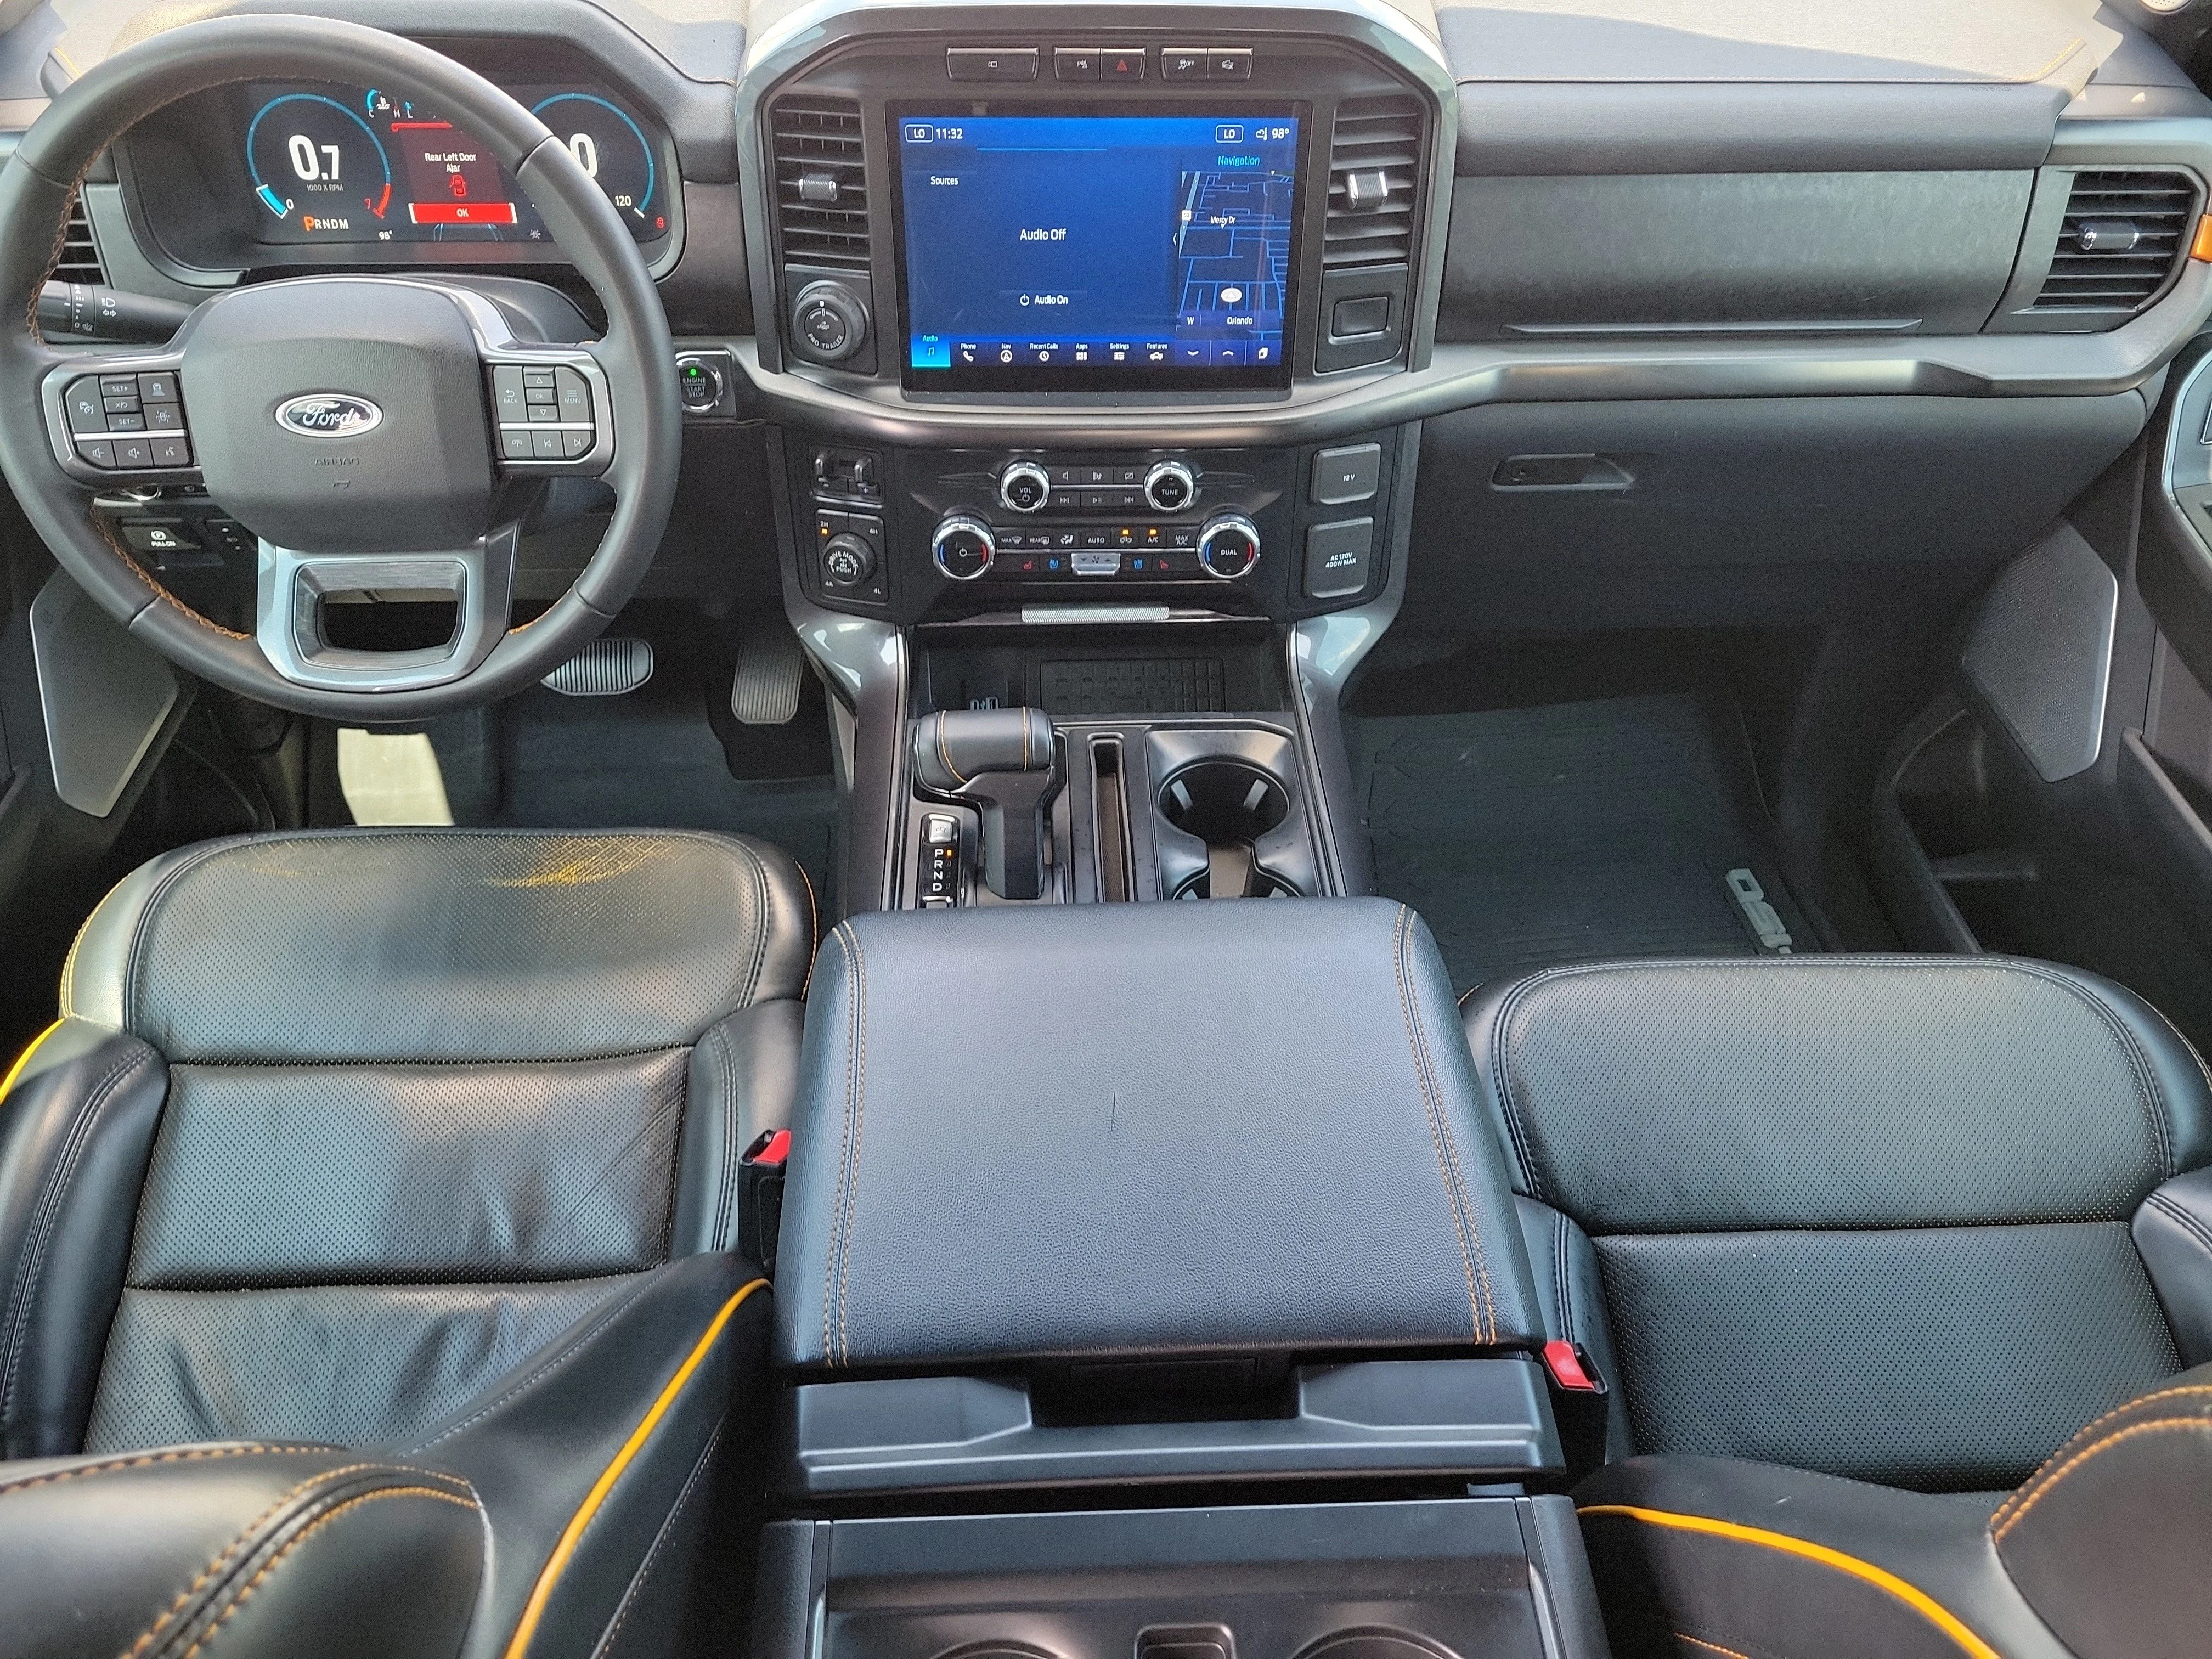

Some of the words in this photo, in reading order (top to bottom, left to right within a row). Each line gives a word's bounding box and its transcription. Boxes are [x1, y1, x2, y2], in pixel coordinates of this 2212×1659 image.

[393, 109, 400, 118] H
[407, 110, 413, 119] L
[913, 128, 925, 138] LO
[936, 128, 963, 139] 11:32
[1224, 129, 1235, 139] LO
[1272, 128, 1289, 139] 98°
[288, 134, 340, 180] 0.7
[424, 153, 441, 161] Rear
[443, 153, 459, 161] Left
[459, 153, 476, 162] Door
[1217, 156, 1260, 166] Navigation
[446, 163, 460, 173] Ajar
[930, 176, 958, 185] Sources
[306, 184, 322, 192] 1000
[286, 199, 294, 210] 0
[364, 198, 371, 209] 7
[615, 195, 631, 206] 120
[456, 208, 469, 217] OK
[1210, 216, 1228, 225] Mercy
[1228, 216, 1235, 224] Dr
[1020, 228, 1048, 241] Audio
[1050, 228, 1066, 241] Off
[1034, 295, 1056, 305] Audio
[1057, 295, 1068, 305] On
[1187, 317, 1194, 325] W
[1227, 317, 1253, 325] Orlando
[808, 333, 820, 346] PRO
[821, 335, 844, 349] TRAILER
[302, 402, 364, 427] Ford
[1325, 560, 1343, 568] 400W
[934, 849, 944, 857] P
[934, 860, 943, 868] R
[933, 871, 943, 881] N
[933, 882, 943, 891] D
